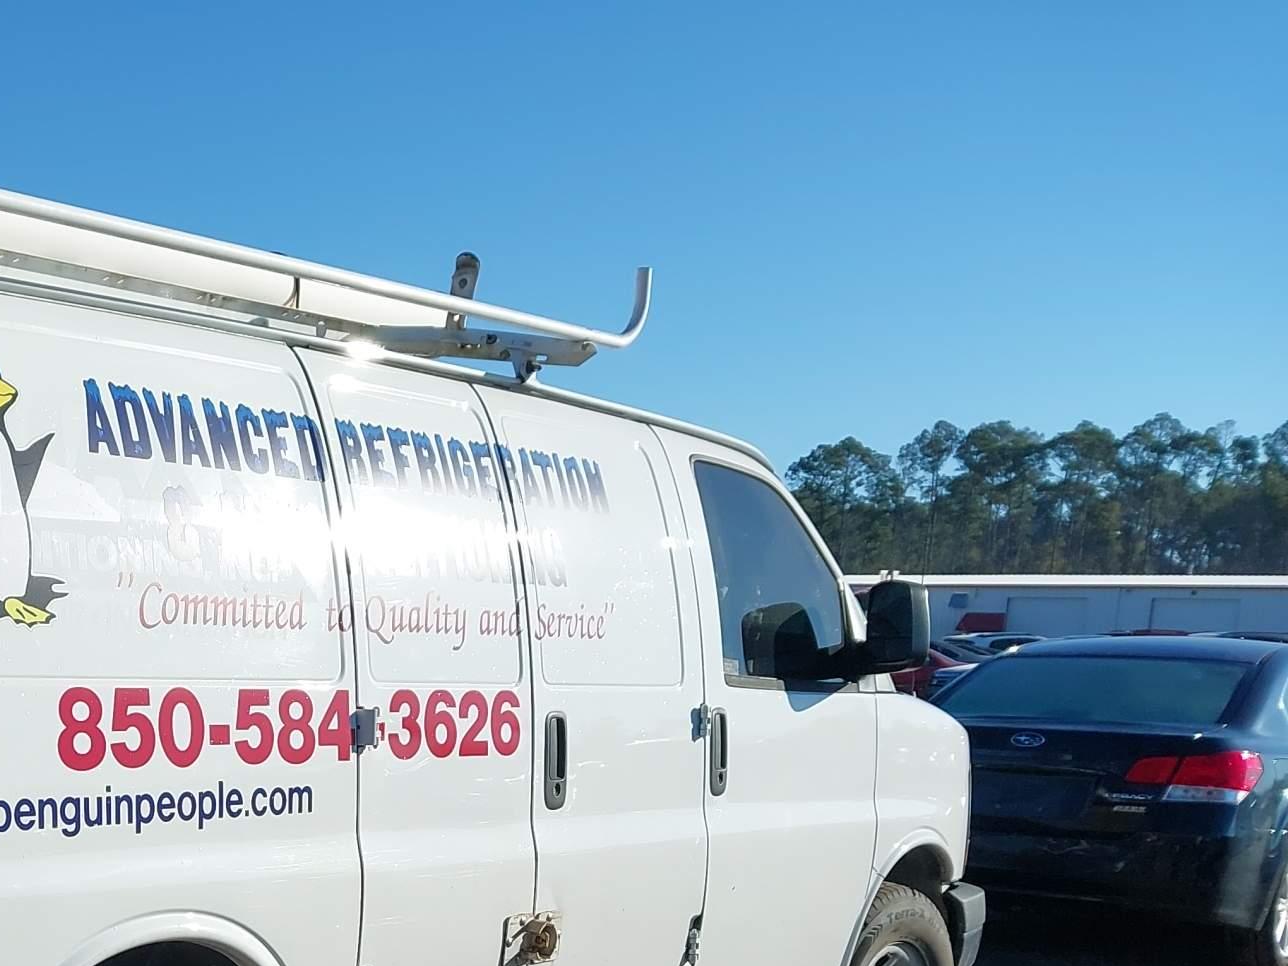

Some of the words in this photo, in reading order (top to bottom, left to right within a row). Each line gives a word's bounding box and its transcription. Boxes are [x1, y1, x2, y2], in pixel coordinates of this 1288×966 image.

[82, 377, 326, 482] ADVANCED
[334, 416, 611, 514] REFRIGERATION
[325, 604, 355, 632] to
[365, 590, 468, 651] Quality
[478, 596, 524, 637] and
